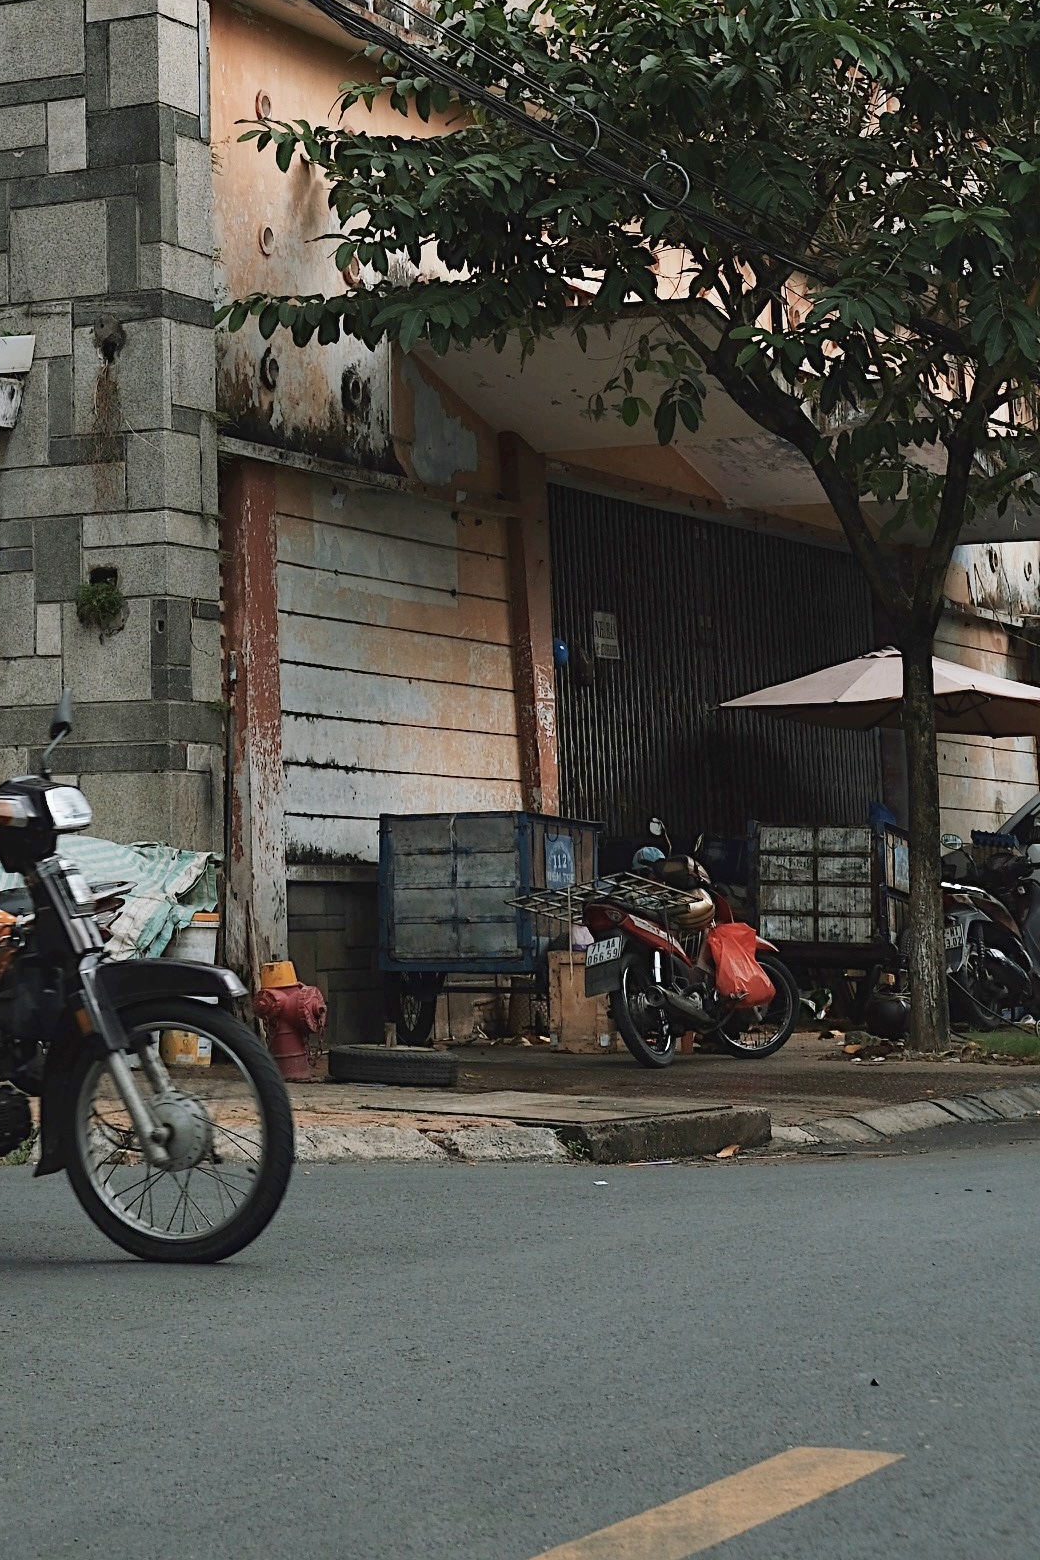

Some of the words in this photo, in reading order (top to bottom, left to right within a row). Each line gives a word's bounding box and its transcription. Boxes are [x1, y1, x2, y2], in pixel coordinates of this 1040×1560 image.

[553, 853, 567, 869] 112
[591, 938, 616, 955] 71-AA
[587, 947, 618, 966] 066.59
